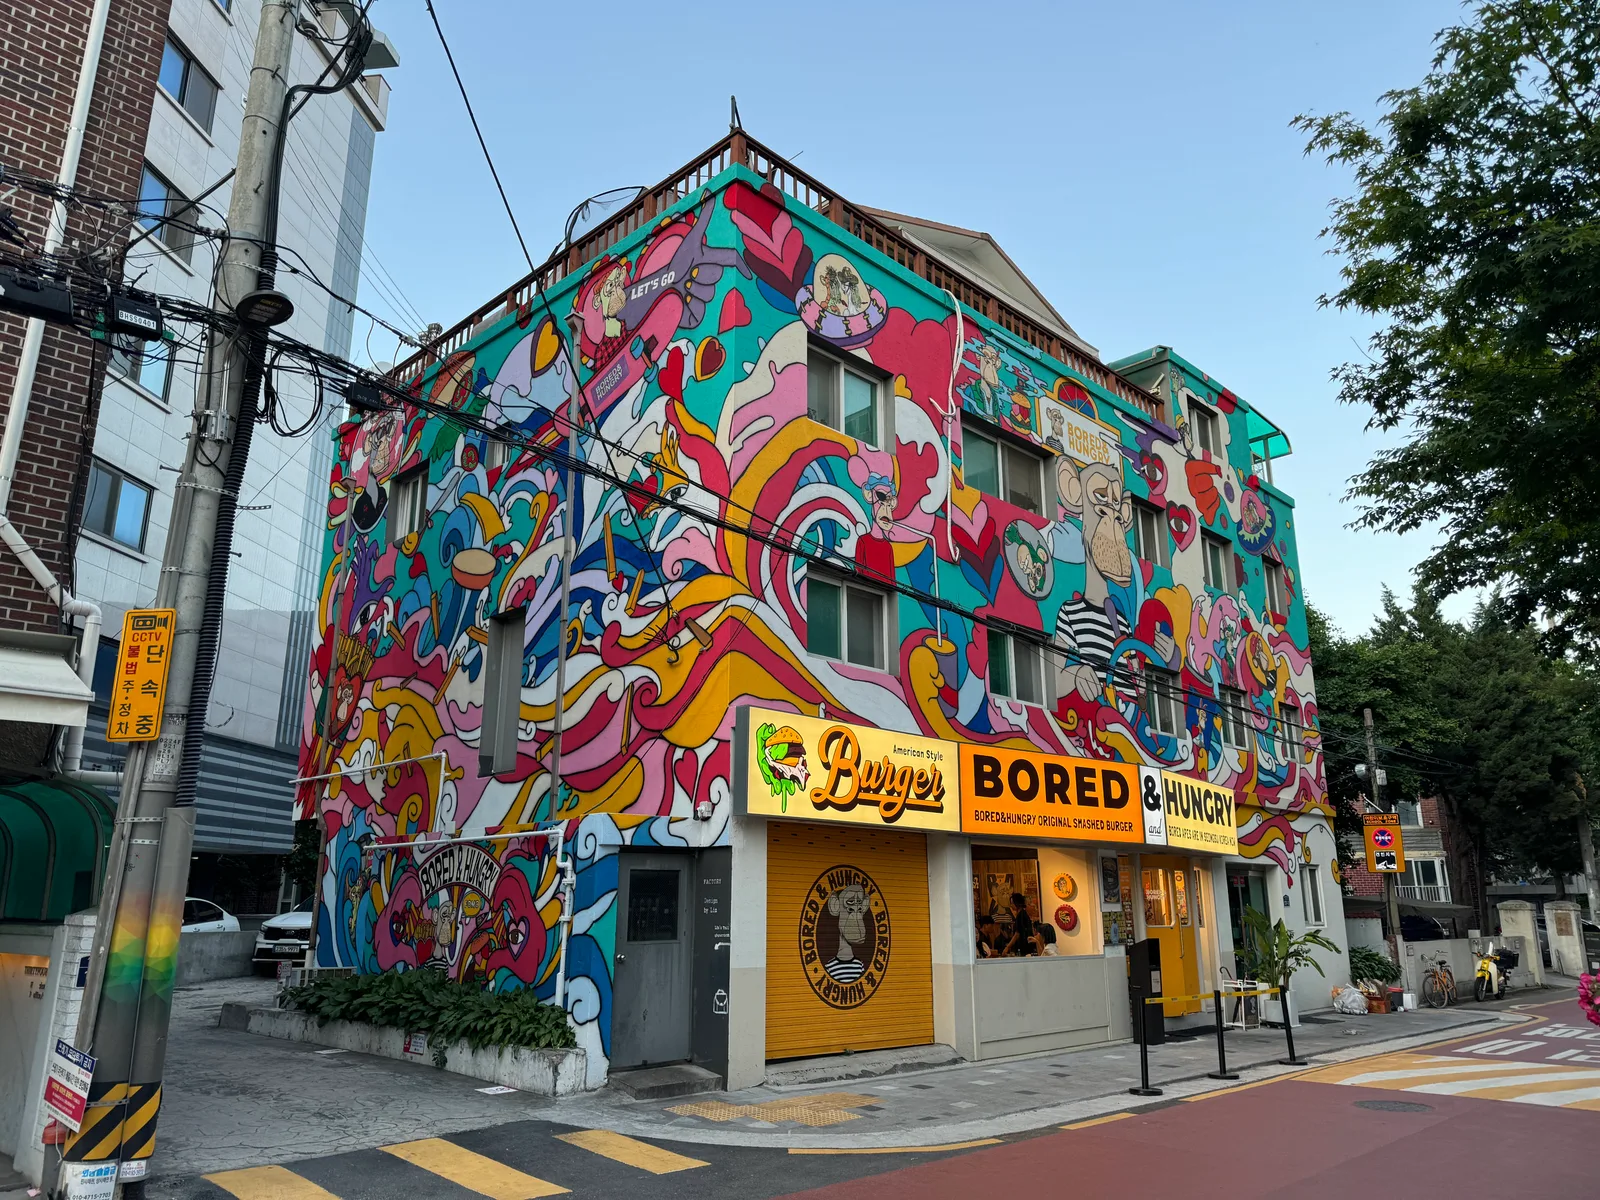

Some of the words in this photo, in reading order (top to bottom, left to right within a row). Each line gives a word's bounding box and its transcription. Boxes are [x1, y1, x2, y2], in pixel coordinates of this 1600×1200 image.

[631, 278, 660, 300] LET'S
[661, 271, 676, 286] GO
[595, 363, 622, 394] BORED&
[597, 369, 623, 400] HUNGRY
[1067, 421, 1109, 454] BORED&
[1069, 437, 1110, 464] HUNGRY
[132, 632, 162, 642] CCTV
[892, 744, 924, 758] American
[926, 748, 944, 762] Style
[810, 725, 945, 823] Burger
[973, 754, 1130, 809] BORED
[1144, 774, 1162, 812] &
[1164, 778, 1232, 828] HUNGRY
[974, 810, 1036, 826] BORED&HUNGRY
[1038, 816, 1072, 828] ORIGINAL
[1073, 818, 1104, 830] SMASHED
[1106, 820, 1133, 832] BURGER
[1148, 818, 1162, 834] and
[420, 848, 454, 896] BORED
[463, 848, 499, 896] HUNGRY
[802, 899, 820, 966] BORED
[816, 884, 828, 900] &
[827, 870, 876, 896] HUNGRY
[874, 910, 889, 972] BORED
[815, 974, 866, 1005] HUNGRY
[865, 971, 876, 988] &
